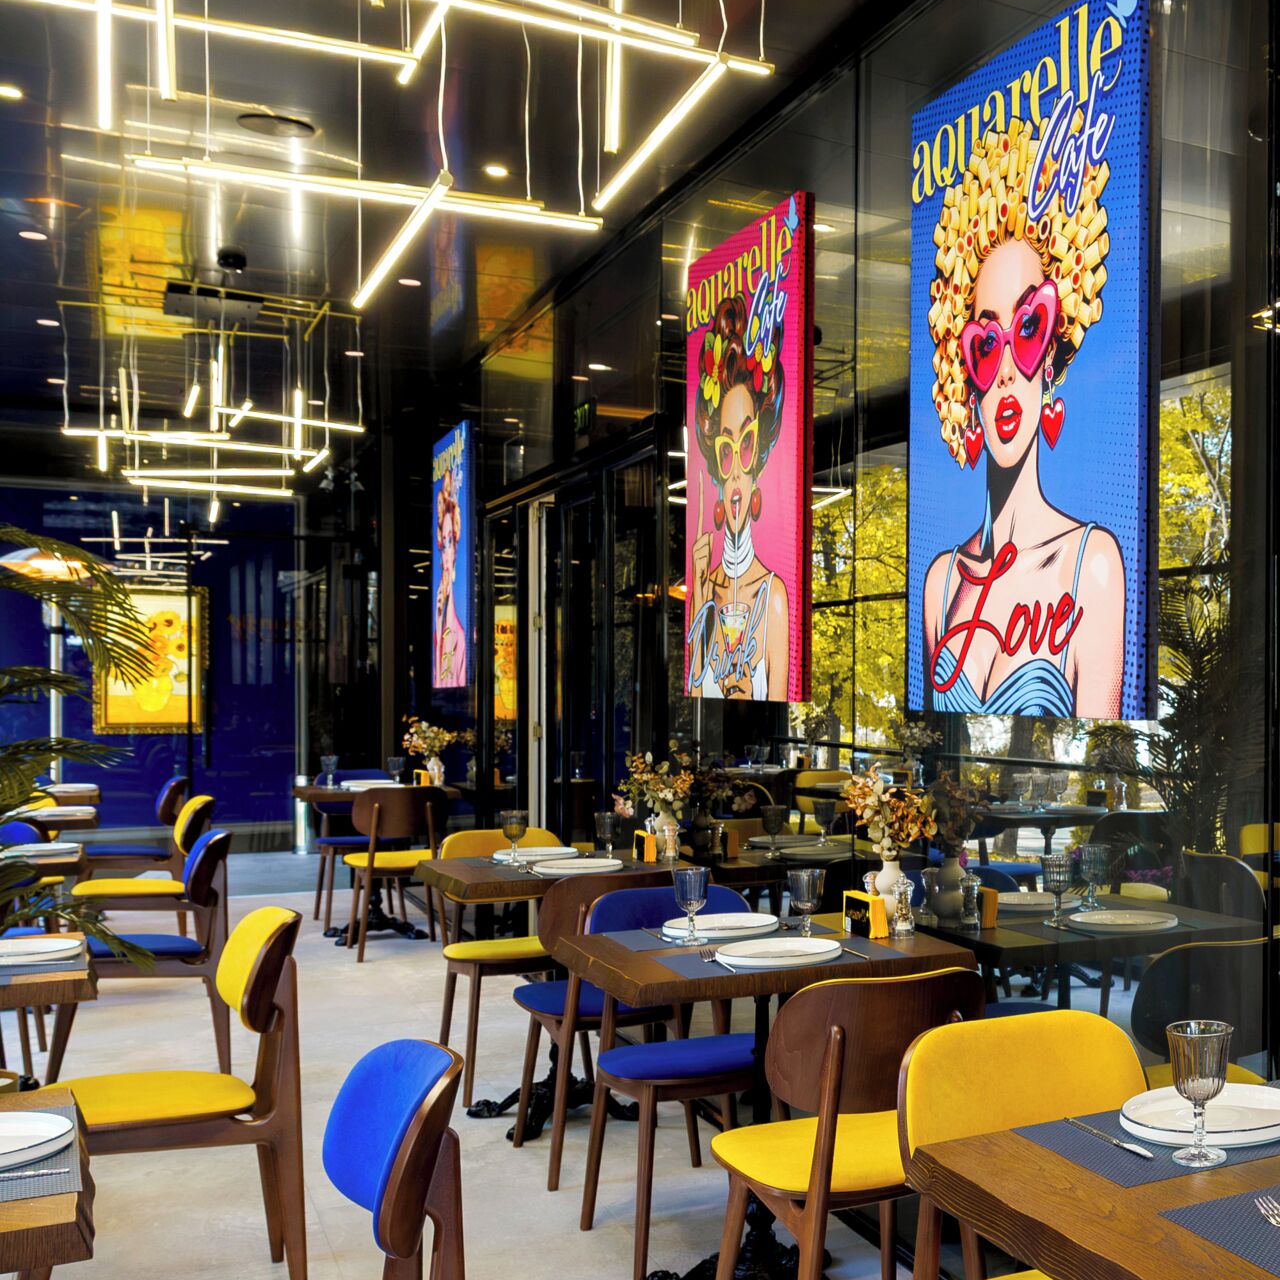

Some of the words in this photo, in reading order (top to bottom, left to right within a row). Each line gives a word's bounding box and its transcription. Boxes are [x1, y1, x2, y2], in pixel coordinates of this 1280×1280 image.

[912, 3, 1124, 204] aquarelle
[1028, 70, 1115, 220] Cafe
[686, 214, 792, 333] aquarelle
[746, 262, 788, 357] Cafe
[688, 581, 768, 692] Drink
[930, 541, 1083, 692] Love
